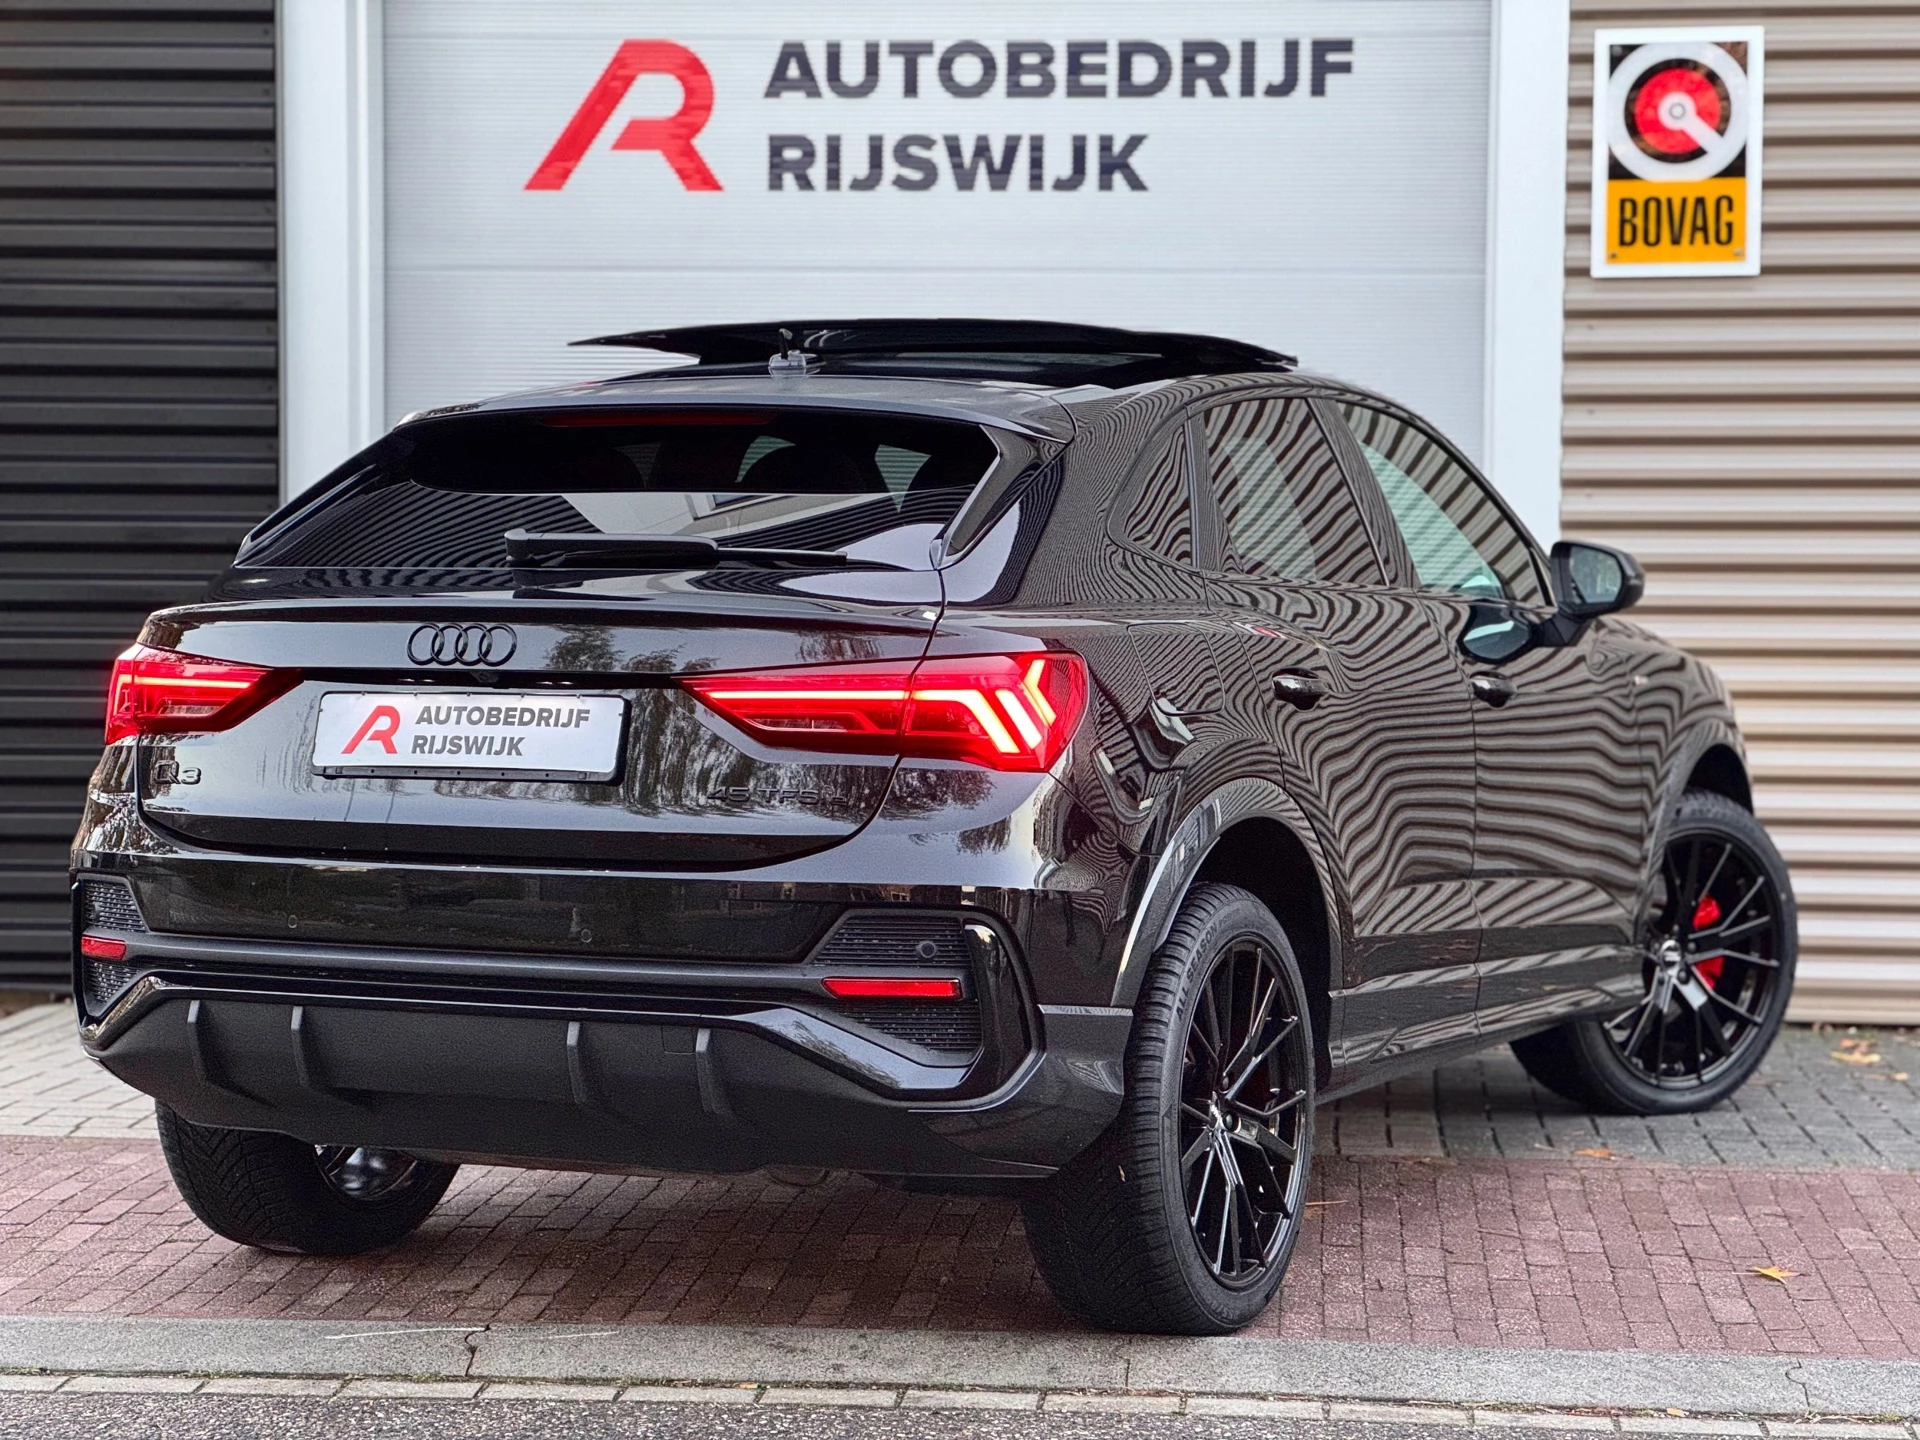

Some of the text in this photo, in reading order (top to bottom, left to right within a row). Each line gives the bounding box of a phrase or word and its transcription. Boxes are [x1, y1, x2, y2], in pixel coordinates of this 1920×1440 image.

[765, 38, 1354, 99] AUTOBEDRIJF
[767, 134, 1149, 192] RIJSWIJK
[1618, 194, 1734, 247] BOVAG
[415, 705, 591, 729] AUTOBEDRIJF
[411, 735, 525, 757] RIJSWIJK
[153, 760, 202, 785] Q3
[707, 786, 750, 802] 45
[1186, 921, 1218, 984] SEASON
